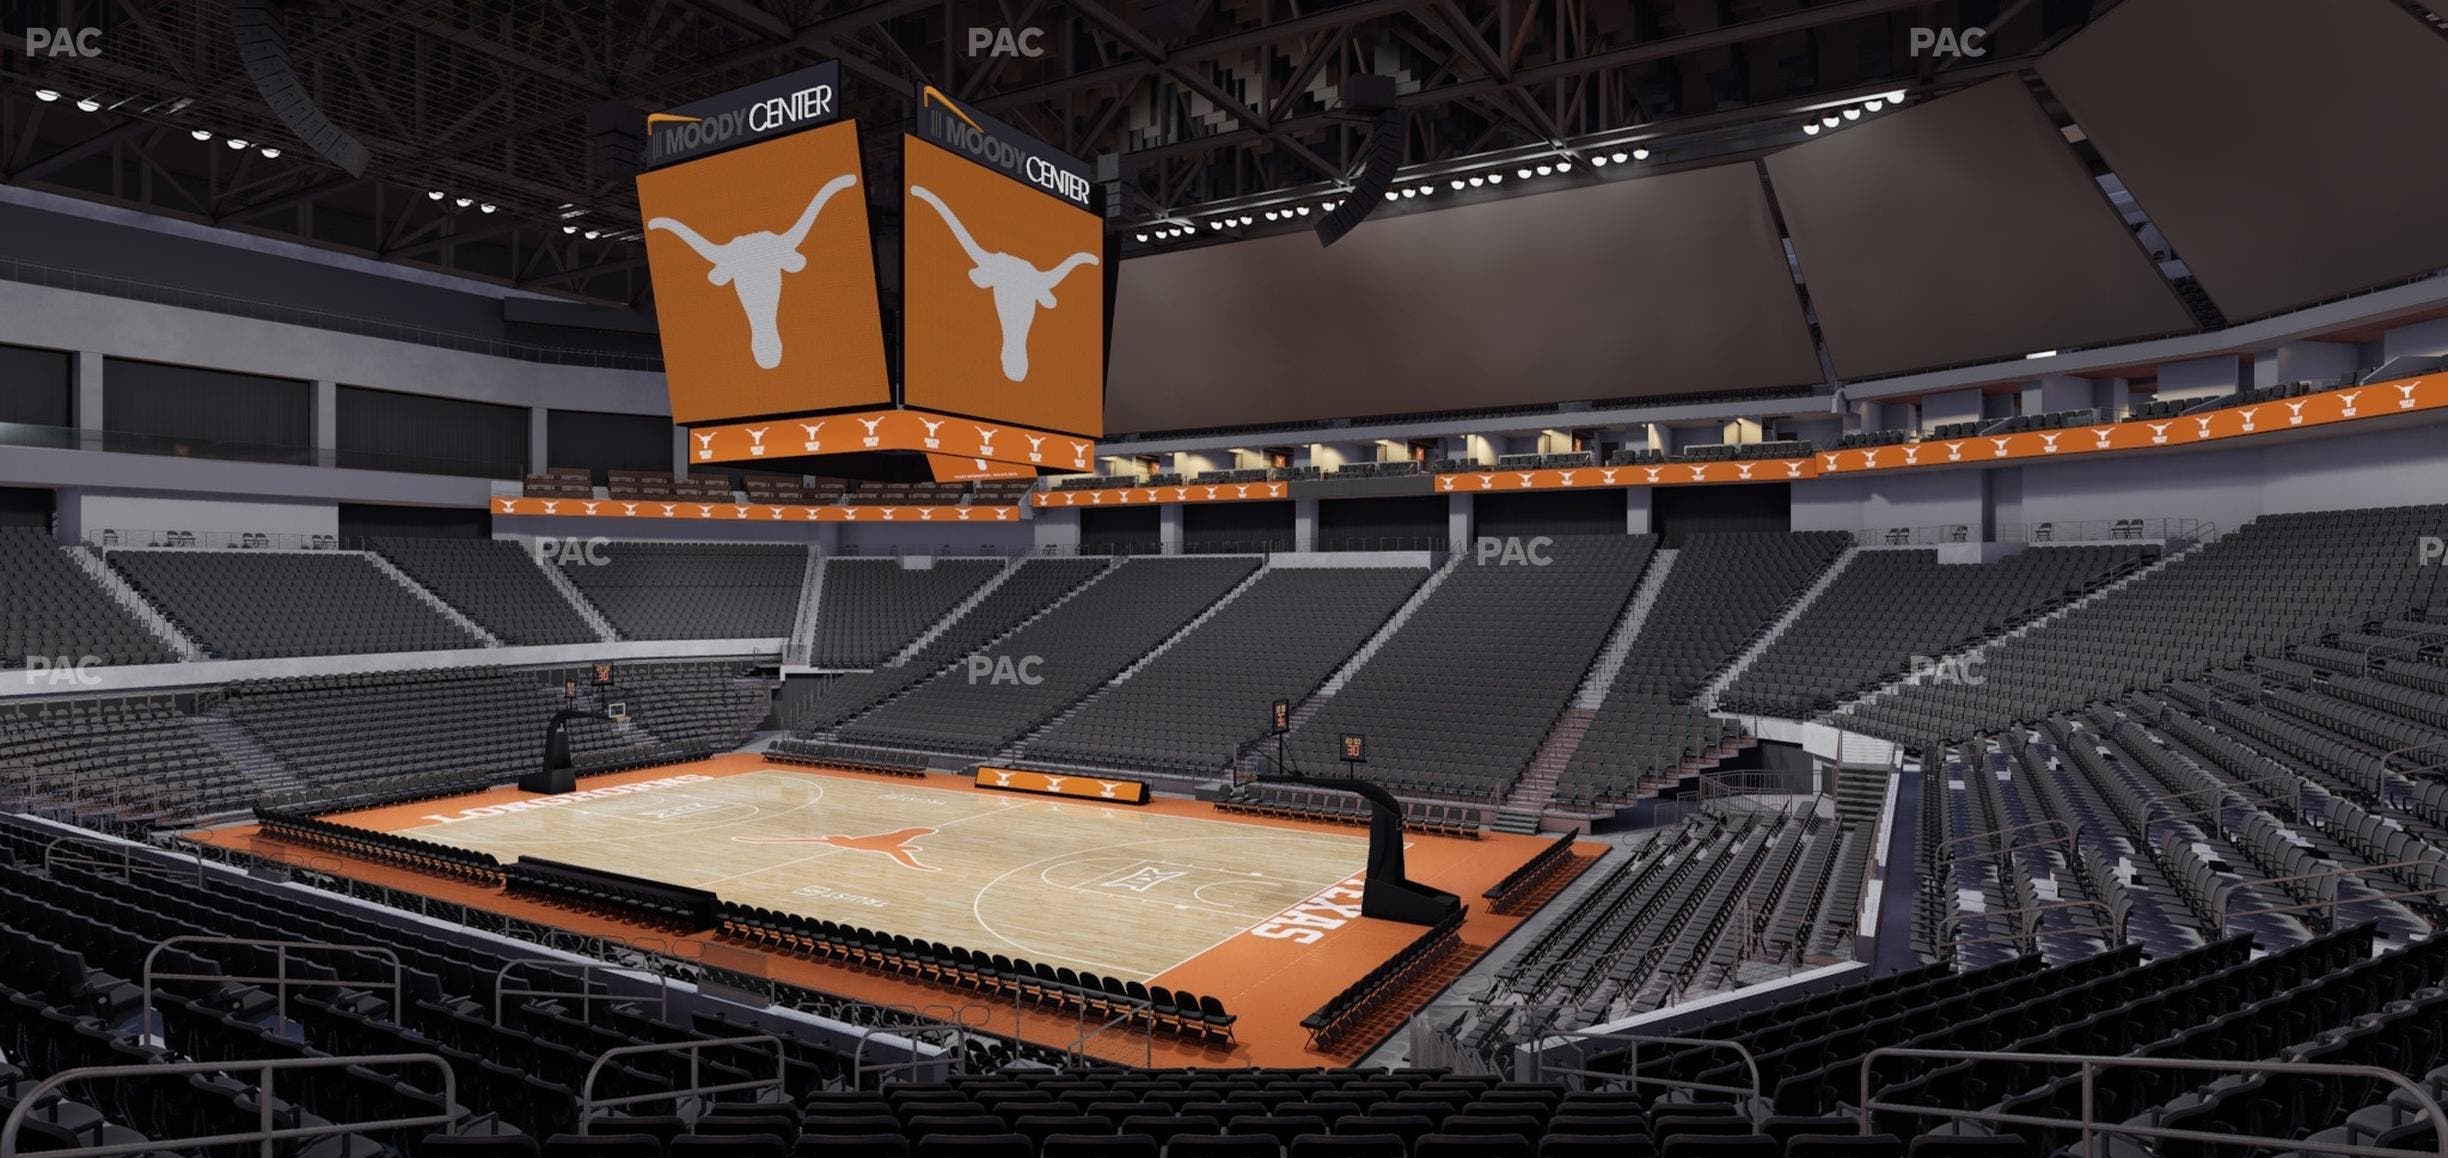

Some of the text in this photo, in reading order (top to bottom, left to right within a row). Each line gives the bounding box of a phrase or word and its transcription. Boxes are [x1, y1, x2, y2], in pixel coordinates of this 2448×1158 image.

[666, 84, 832, 155] MOODY CENTER
[945, 116, 1090, 205] MOODY CENTER
